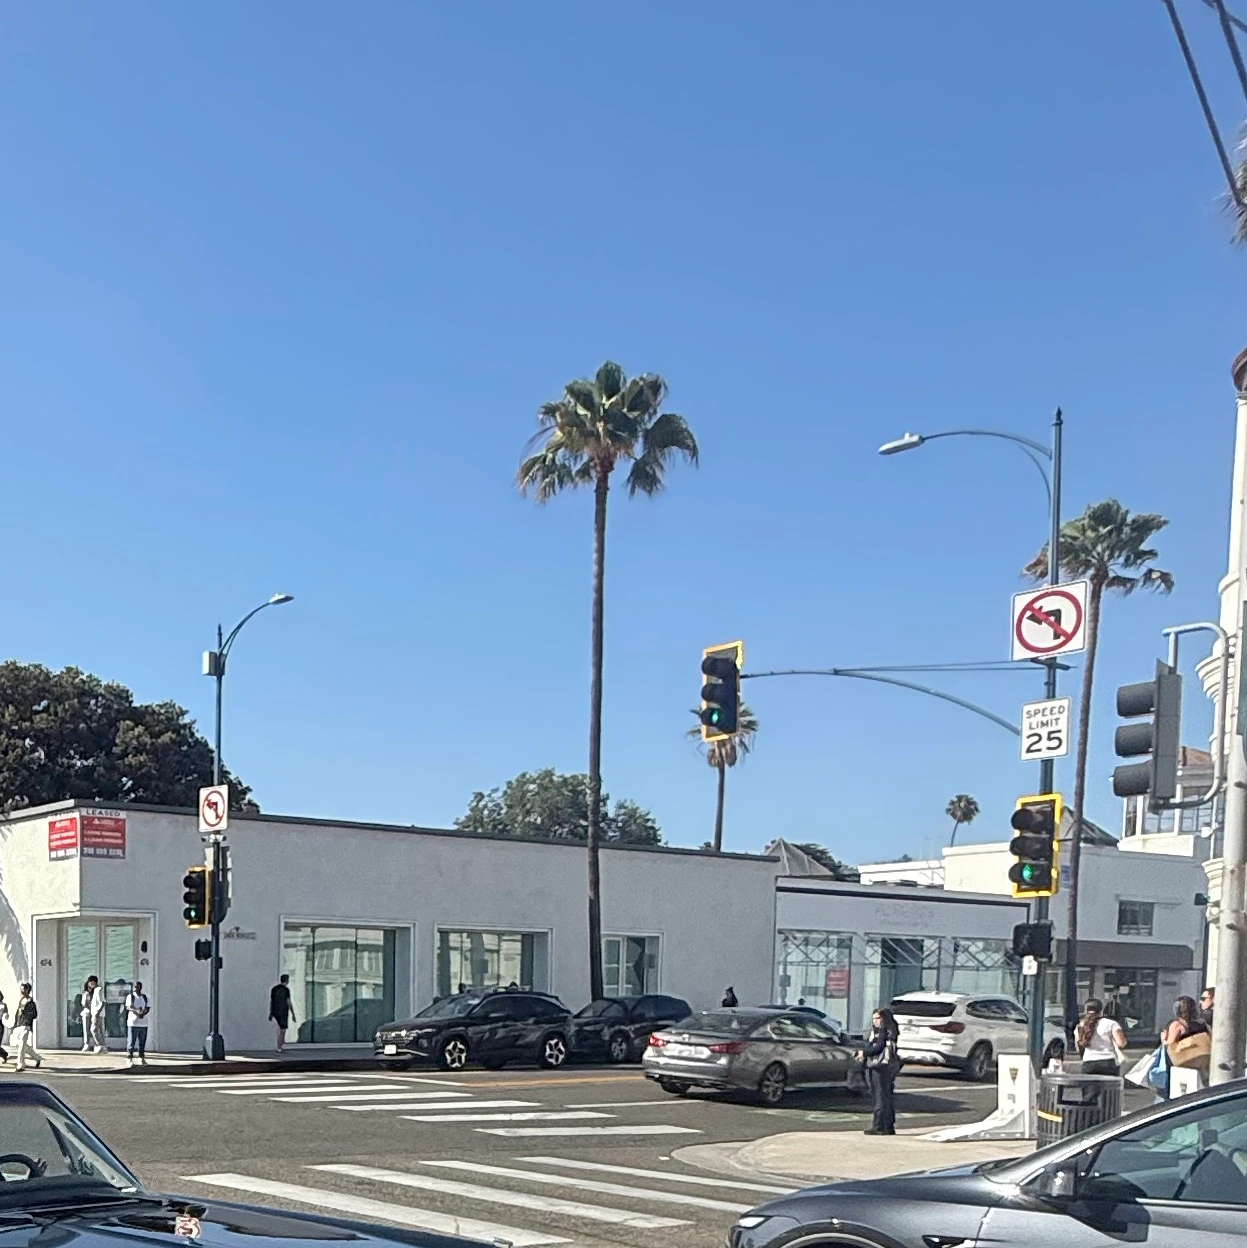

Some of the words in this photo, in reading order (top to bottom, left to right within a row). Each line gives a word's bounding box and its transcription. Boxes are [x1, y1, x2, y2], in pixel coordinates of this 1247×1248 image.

[1026, 705, 1066, 719] SPEED
[1029, 717, 1061, 730] LIMIT
[1025, 729, 1063, 754] 25
[86, 808, 121, 817] LEASED
